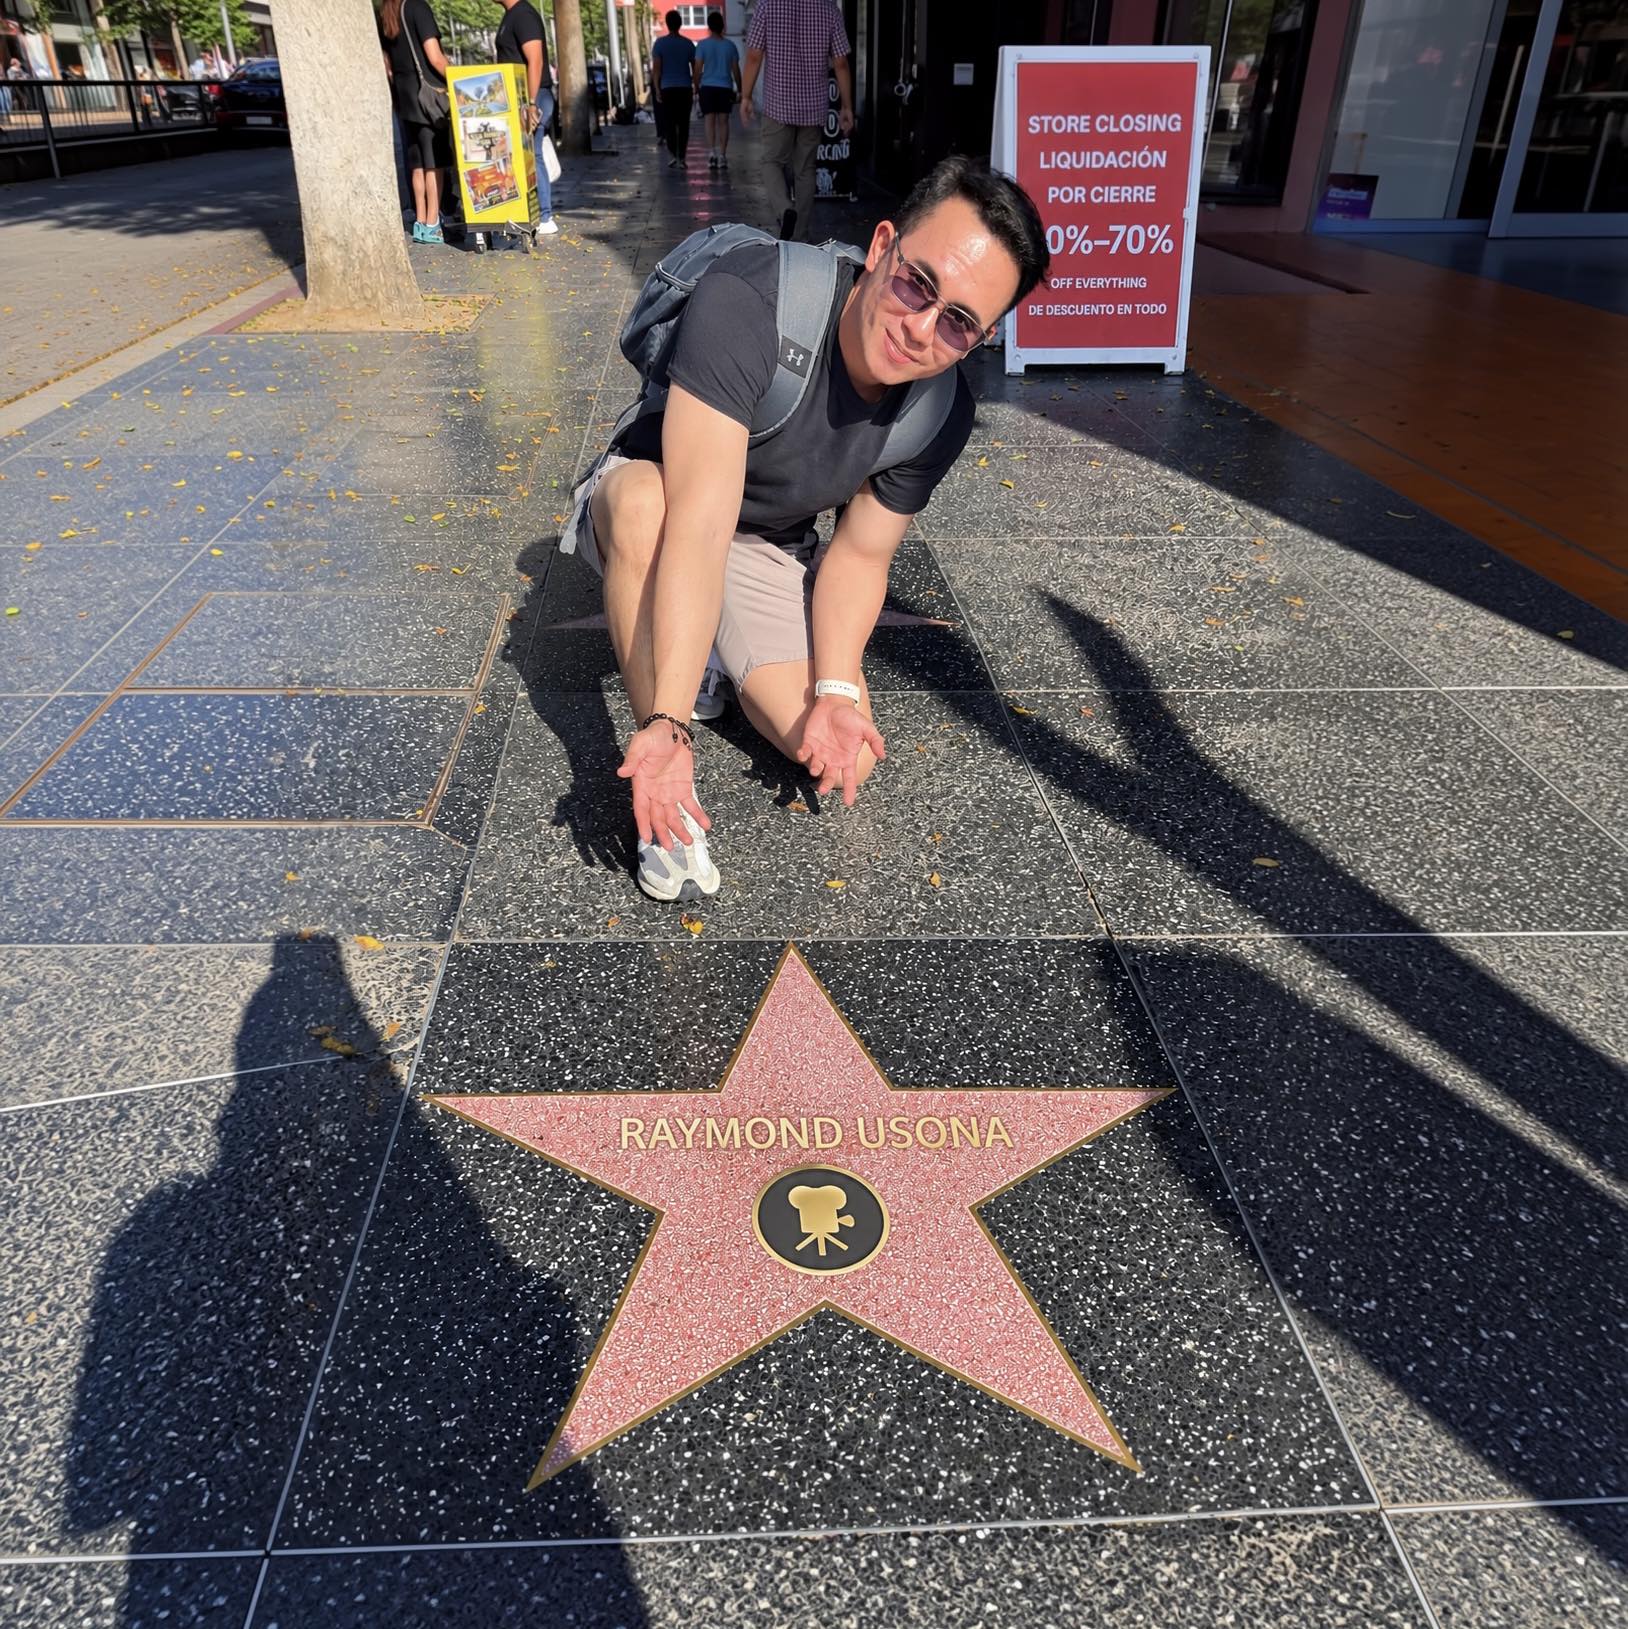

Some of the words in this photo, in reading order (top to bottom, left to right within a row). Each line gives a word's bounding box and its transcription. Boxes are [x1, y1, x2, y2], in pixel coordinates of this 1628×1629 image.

[1028, 115, 1091, 134] STORE
[1095, 113, 1182, 133] CLOSING
[1040, 145, 1167, 170] LIQUIDACIÓN
[1048, 187, 1086, 203] POR
[1090, 186, 1156, 203] CIERRE
[1045, 224, 1174, 255] 0%–70%
[1051, 277, 1073, 289] OFF
[1075, 277, 1147, 289] EVERYTHING
[1028, 305, 1043, 316] DE
[1046, 304, 1115, 316] DESCUENTO
[1117, 304, 1132, 315] EN
[1135, 303, 1167, 315] TODO
[620, 1117, 843, 1150] RAYMOND
[857, 1116, 1014, 1149] USONA
